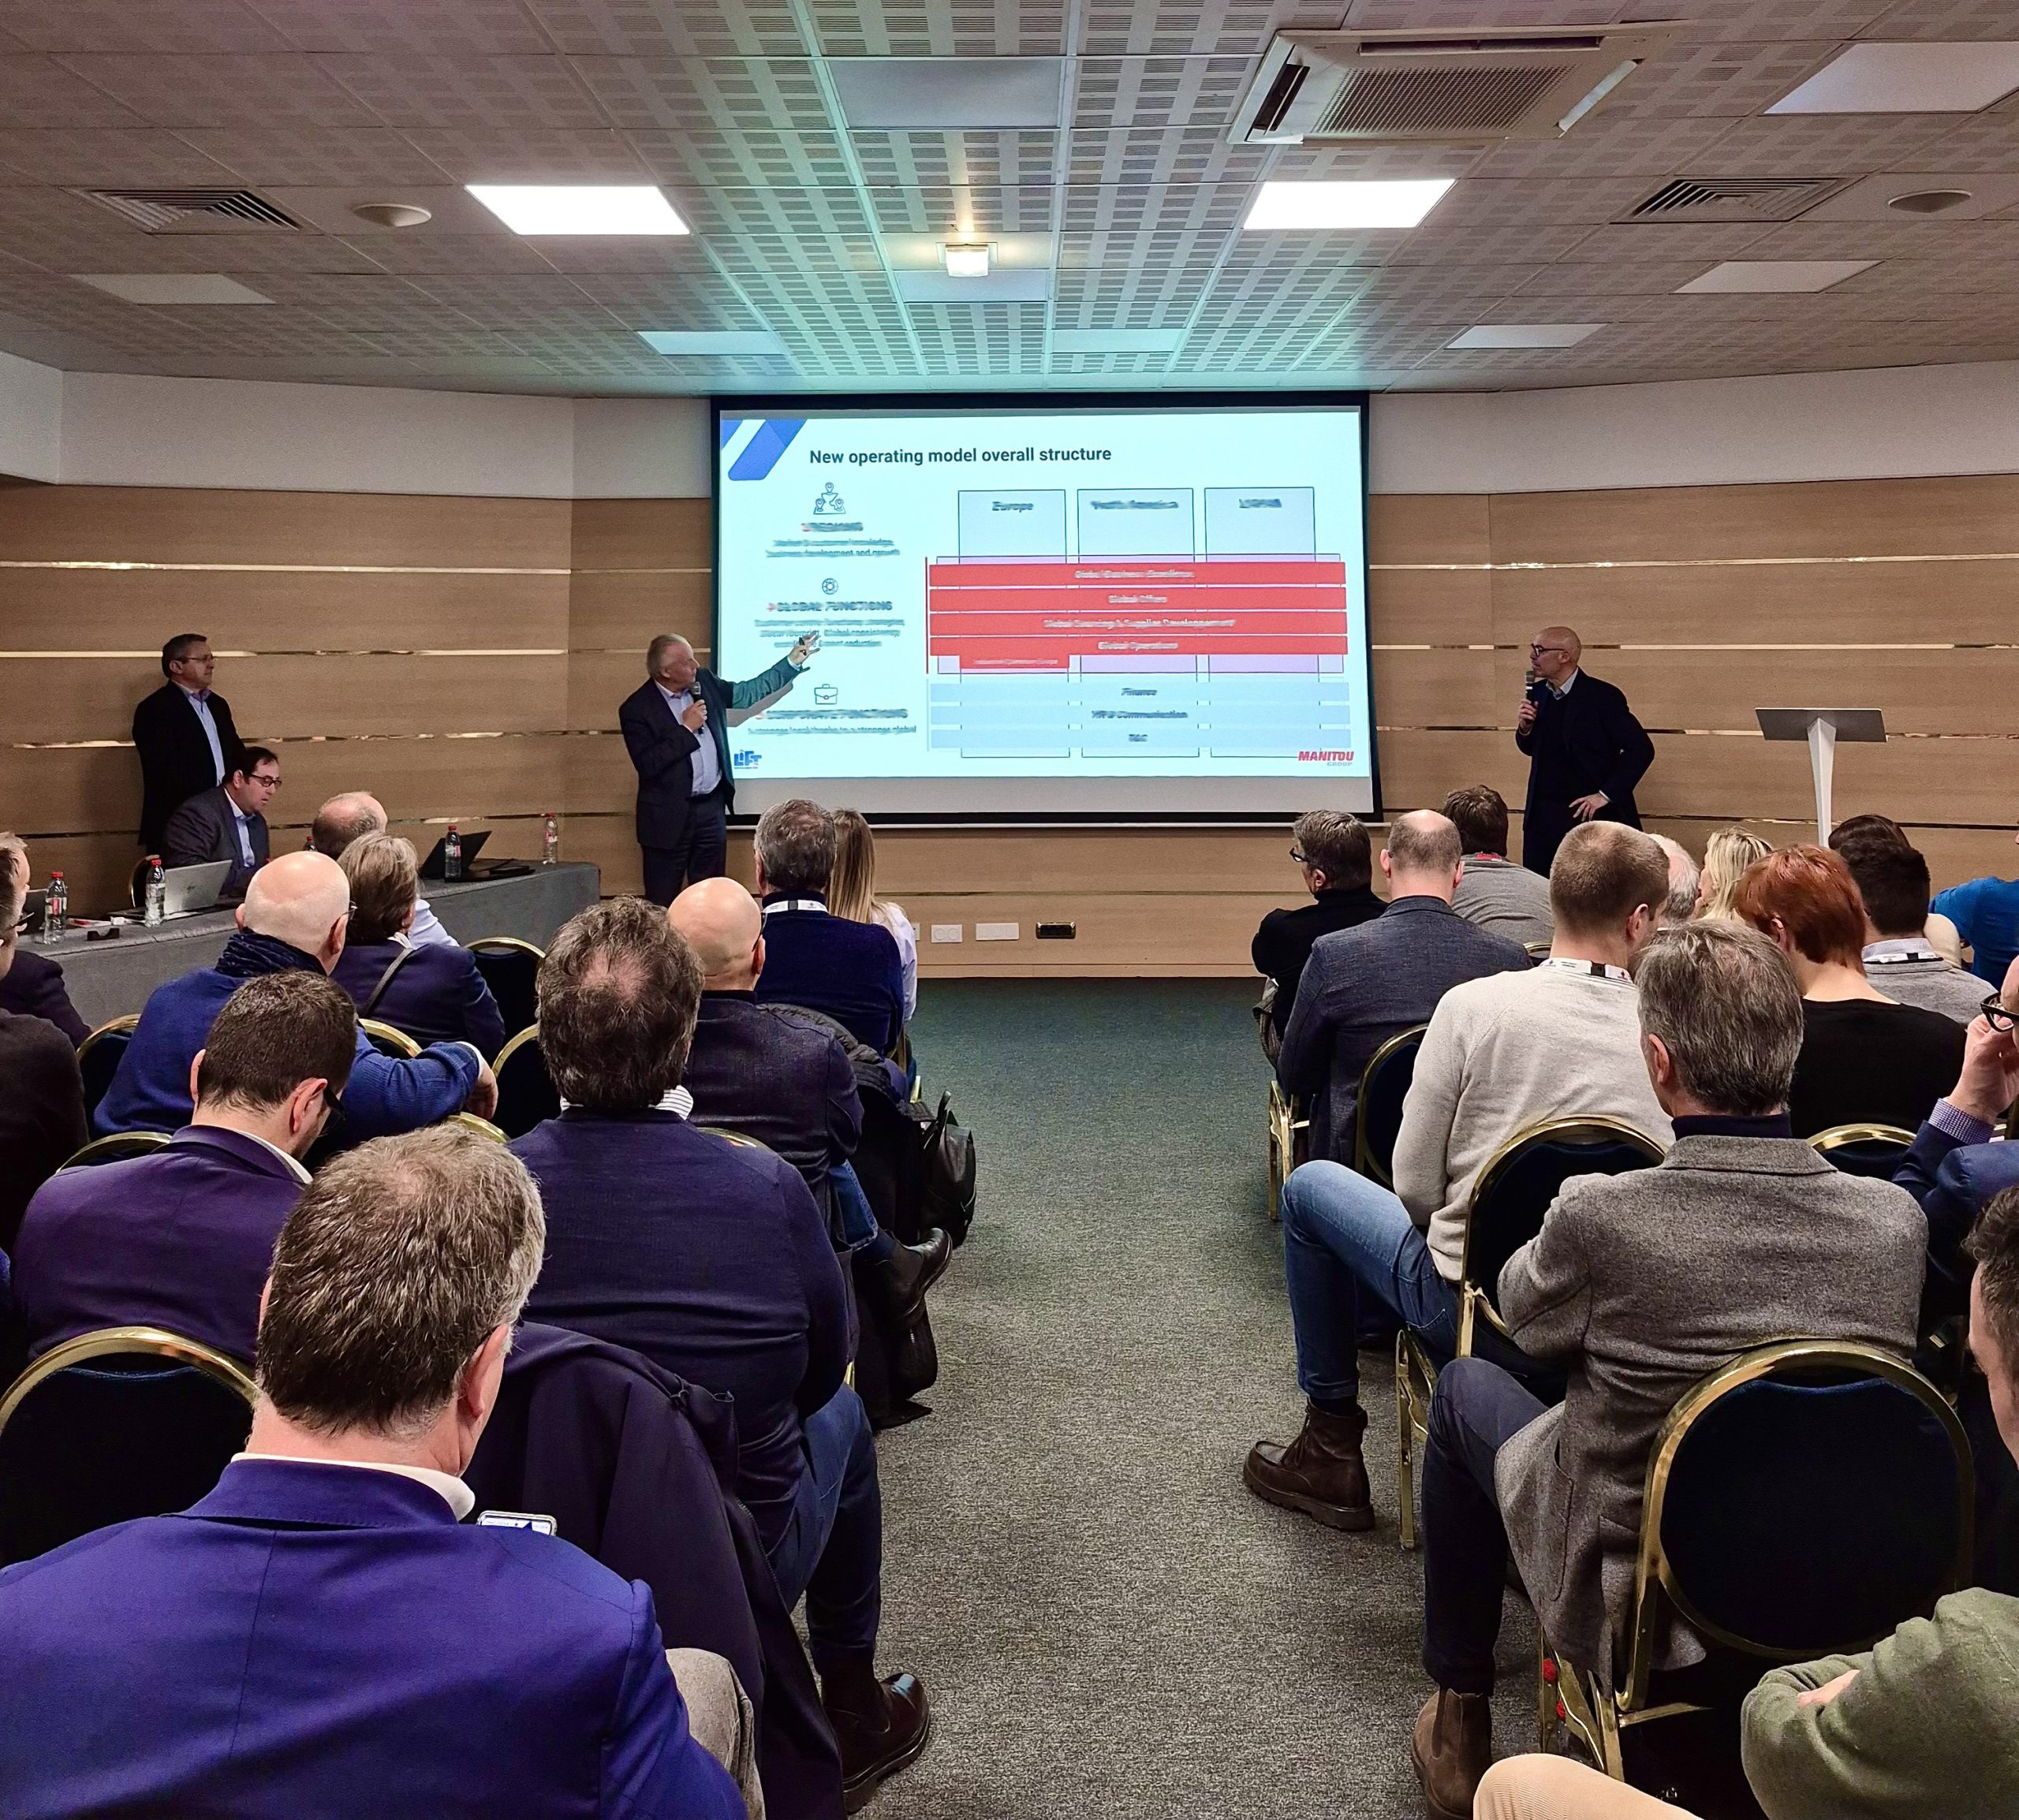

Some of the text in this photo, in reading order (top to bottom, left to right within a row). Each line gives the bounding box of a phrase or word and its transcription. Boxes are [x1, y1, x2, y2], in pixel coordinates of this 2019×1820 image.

[809, 447, 1112, 466] New operating model overall structure
[1298, 751, 1355, 762] MANITOU
